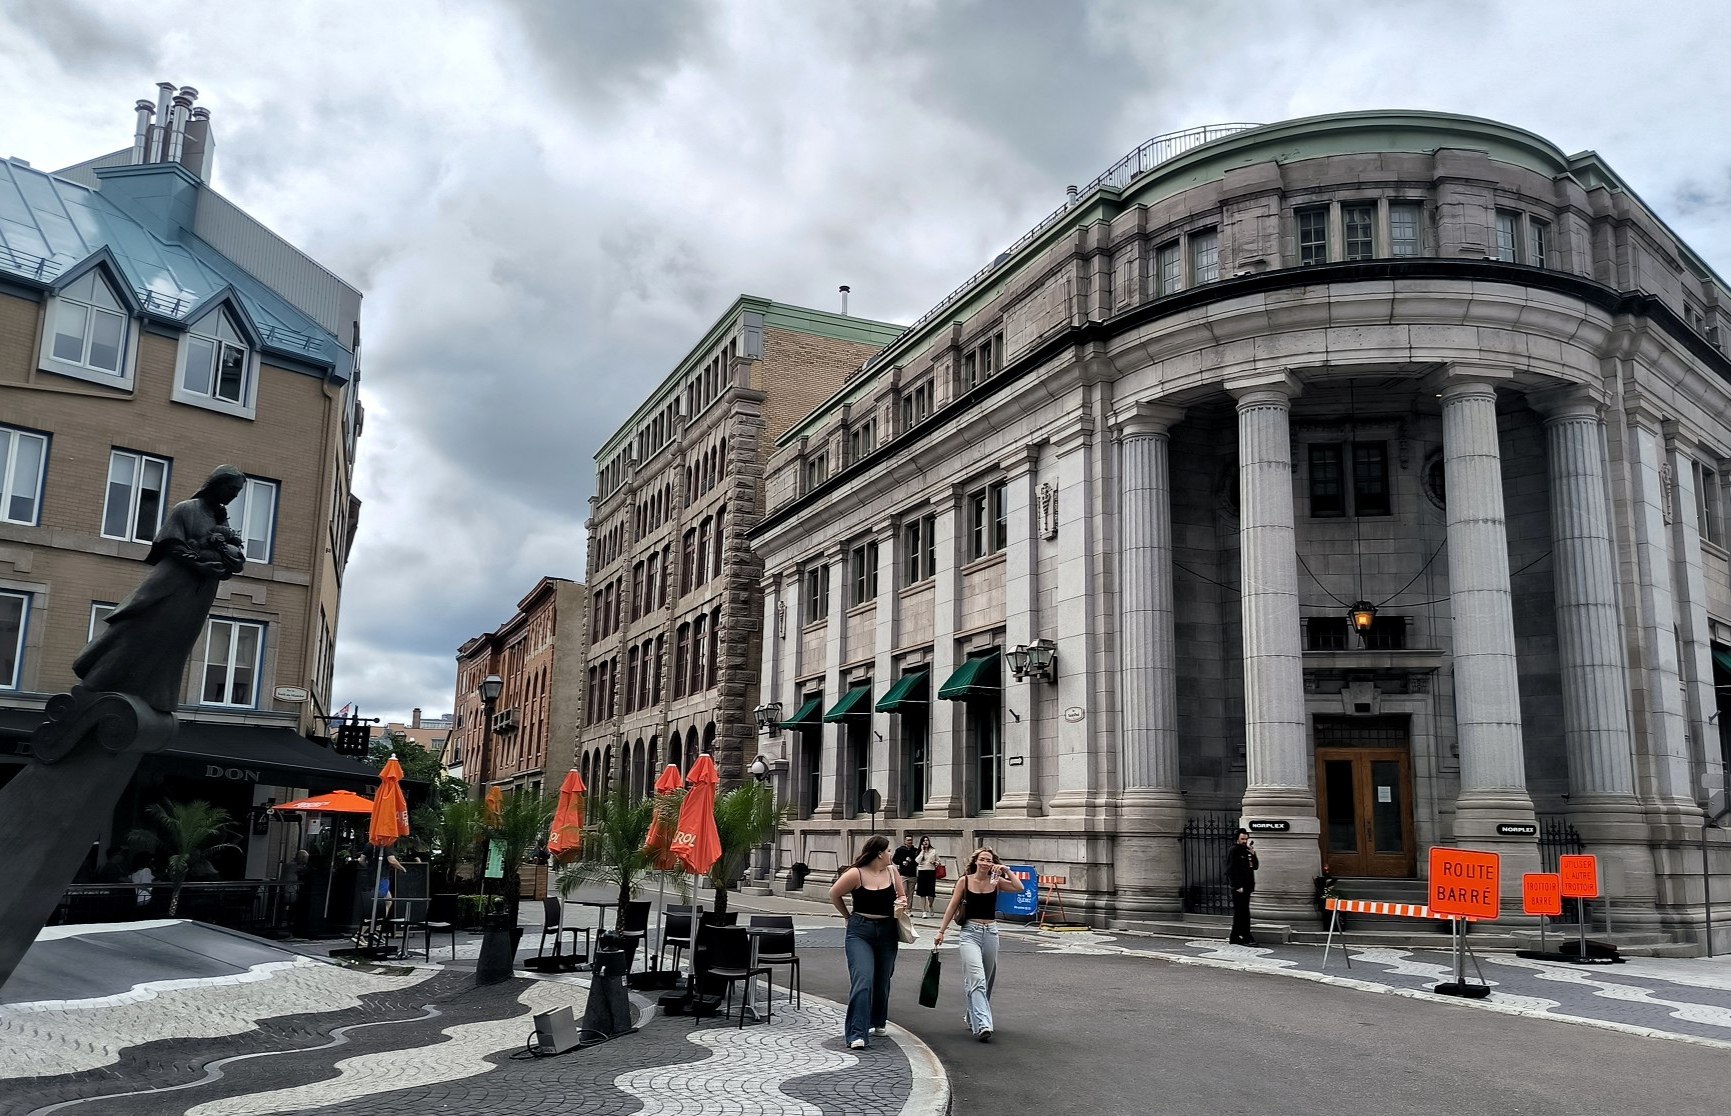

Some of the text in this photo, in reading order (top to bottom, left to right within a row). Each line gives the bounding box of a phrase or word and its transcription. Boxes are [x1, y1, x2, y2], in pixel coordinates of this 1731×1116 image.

[205, 765, 260, 782] DON
[673, 831, 697, 848] ROL
[1443, 861, 1494, 880] ROUTE
[1437, 885, 1491, 905] BARRÉ
[1526, 882, 1557, 892] TROTTOIR
[1564, 882, 1594, 891] TROTTOIR
